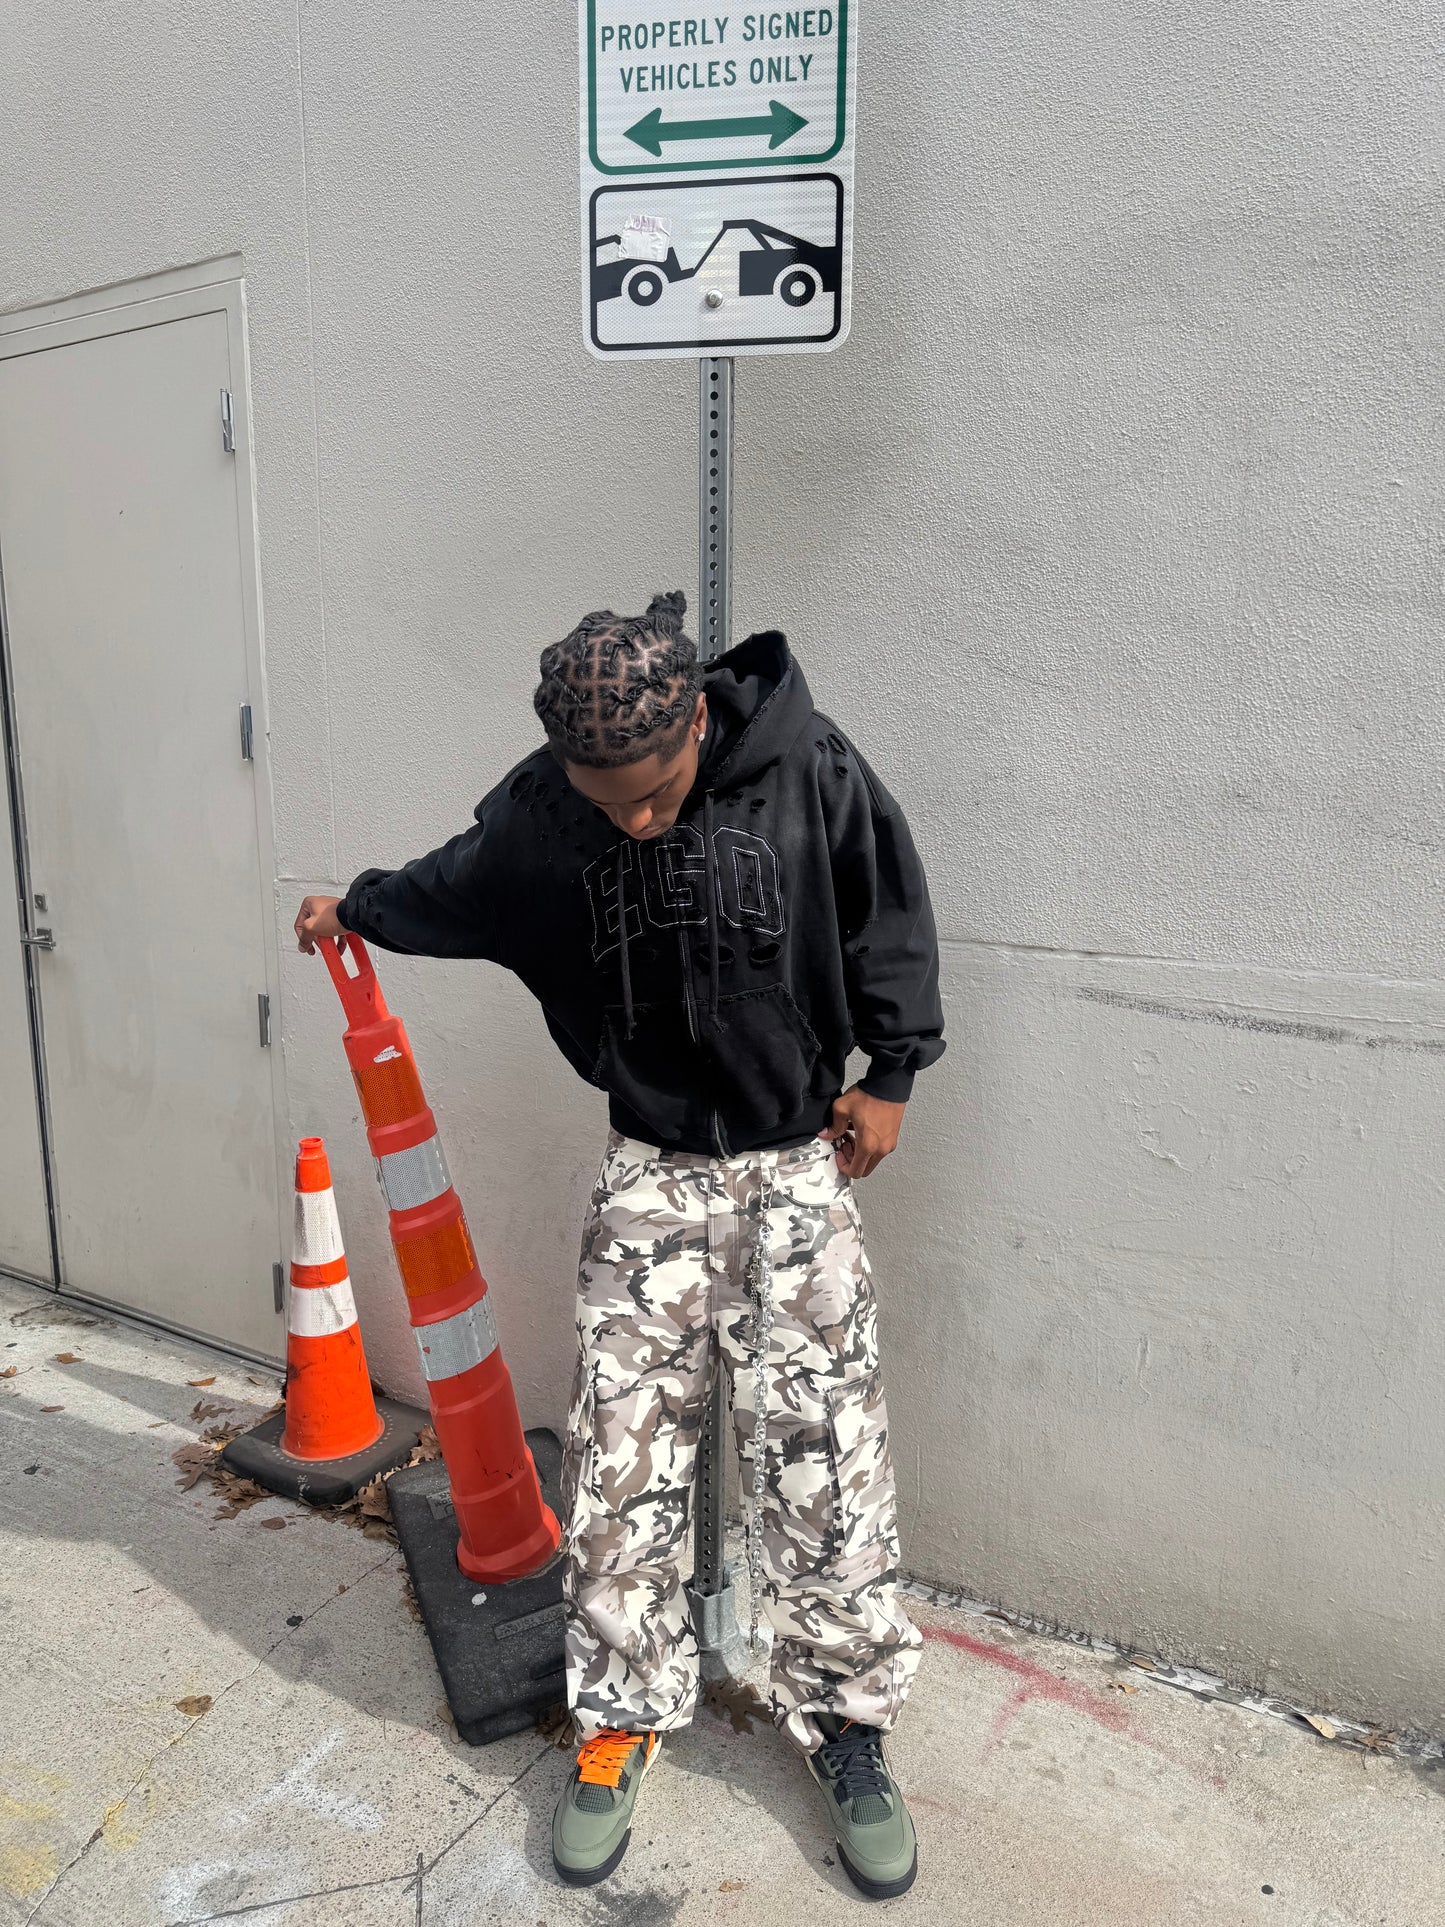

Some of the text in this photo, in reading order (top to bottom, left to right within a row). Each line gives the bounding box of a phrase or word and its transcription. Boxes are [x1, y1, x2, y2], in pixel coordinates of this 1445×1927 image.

[601, 9, 833, 51] PROPERLY SIGNED
[620, 53, 813, 93] VEHICLES ONLY
